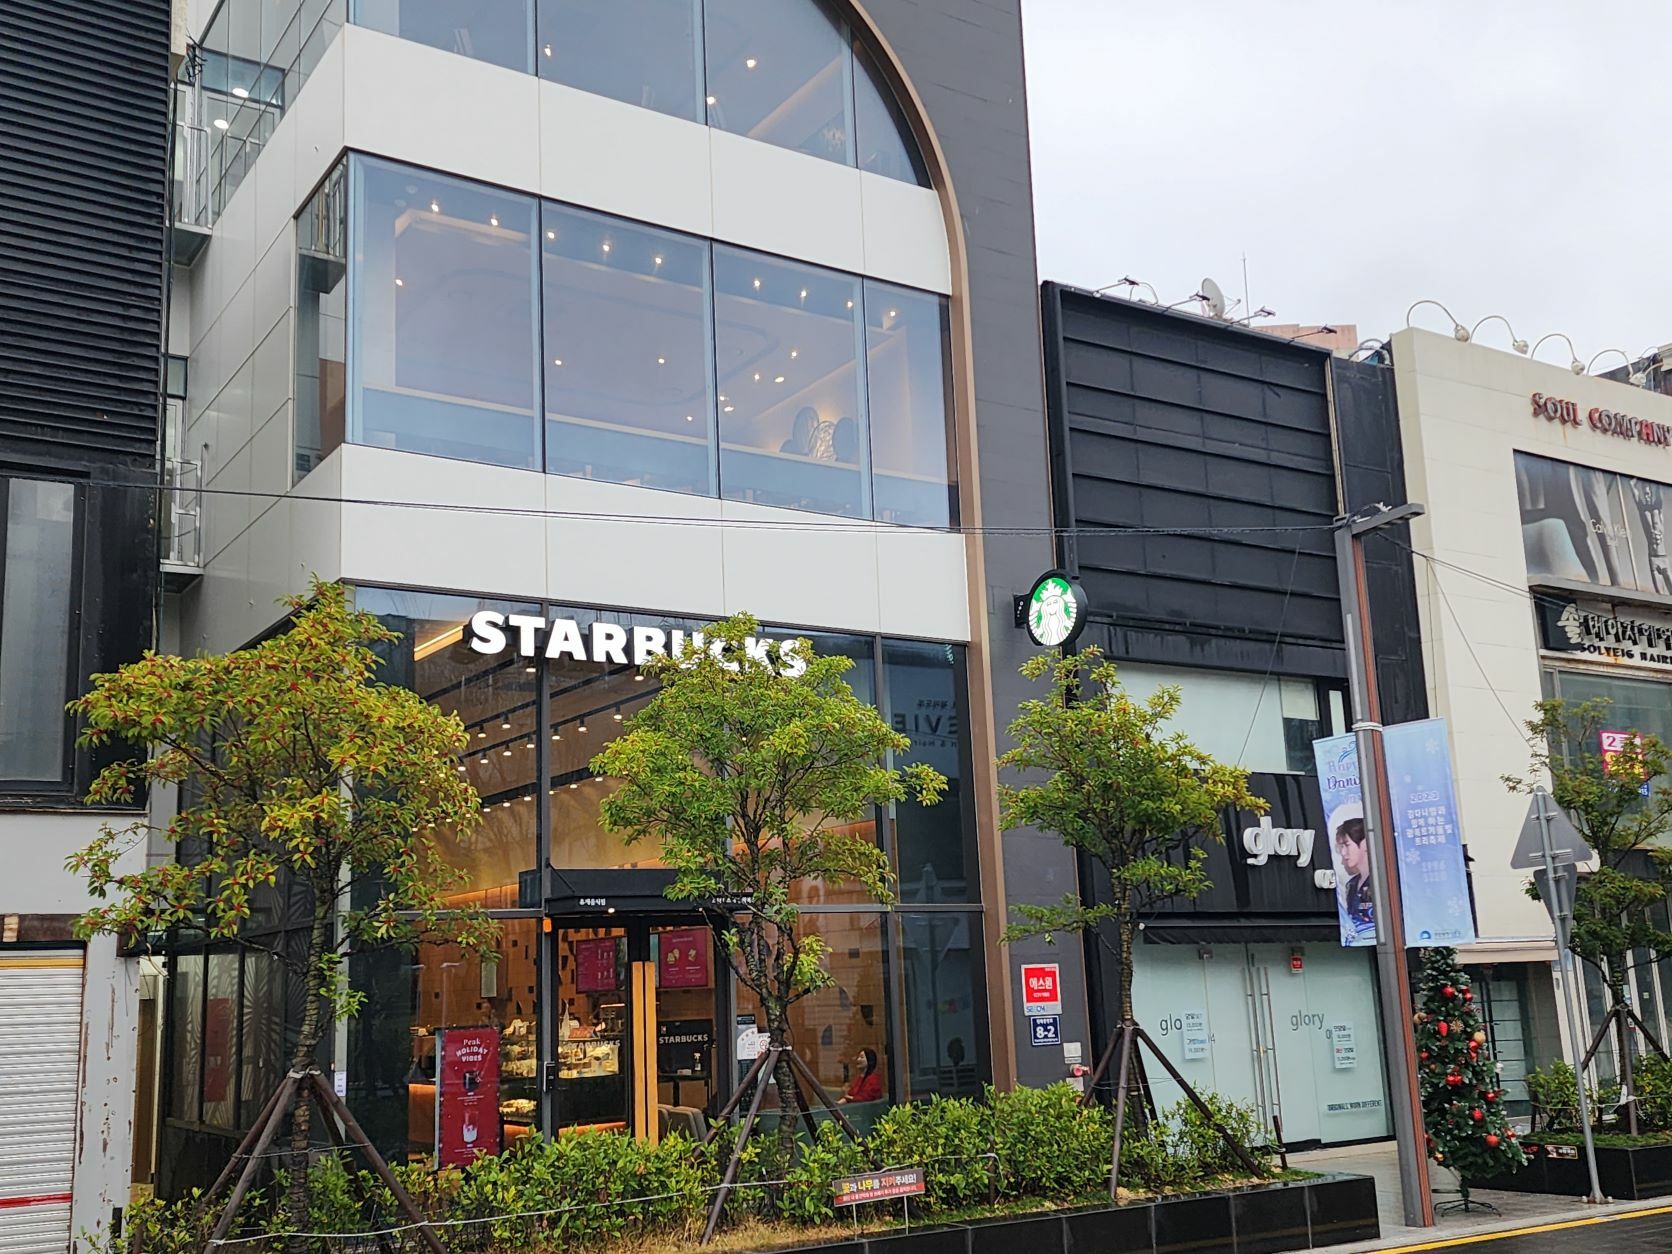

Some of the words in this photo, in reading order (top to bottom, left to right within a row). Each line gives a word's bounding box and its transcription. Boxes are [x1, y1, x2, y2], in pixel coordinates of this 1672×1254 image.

[1531, 392, 1583, 428] SOUL
[1588, 407, 1672, 448] COMPANY
[1327, 774, 1361, 791] Dani
[1243, 816, 1315, 867] glory
[1029, 976, 1053, 990] 에스원
[1160, 1013, 1183, 1037] glo
[1290, 1009, 1325, 1032] glory
[659, 1034, 708, 1044] STARBUCKS
[1036, 1026, 1056, 1039] 8-2
[463, 1037, 481, 1046] Peak
[456, 1046, 489, 1057] HOLIDAY
[461, 1054, 482, 1062] VIBES
[858, 1179, 880, 1191] 나무를
